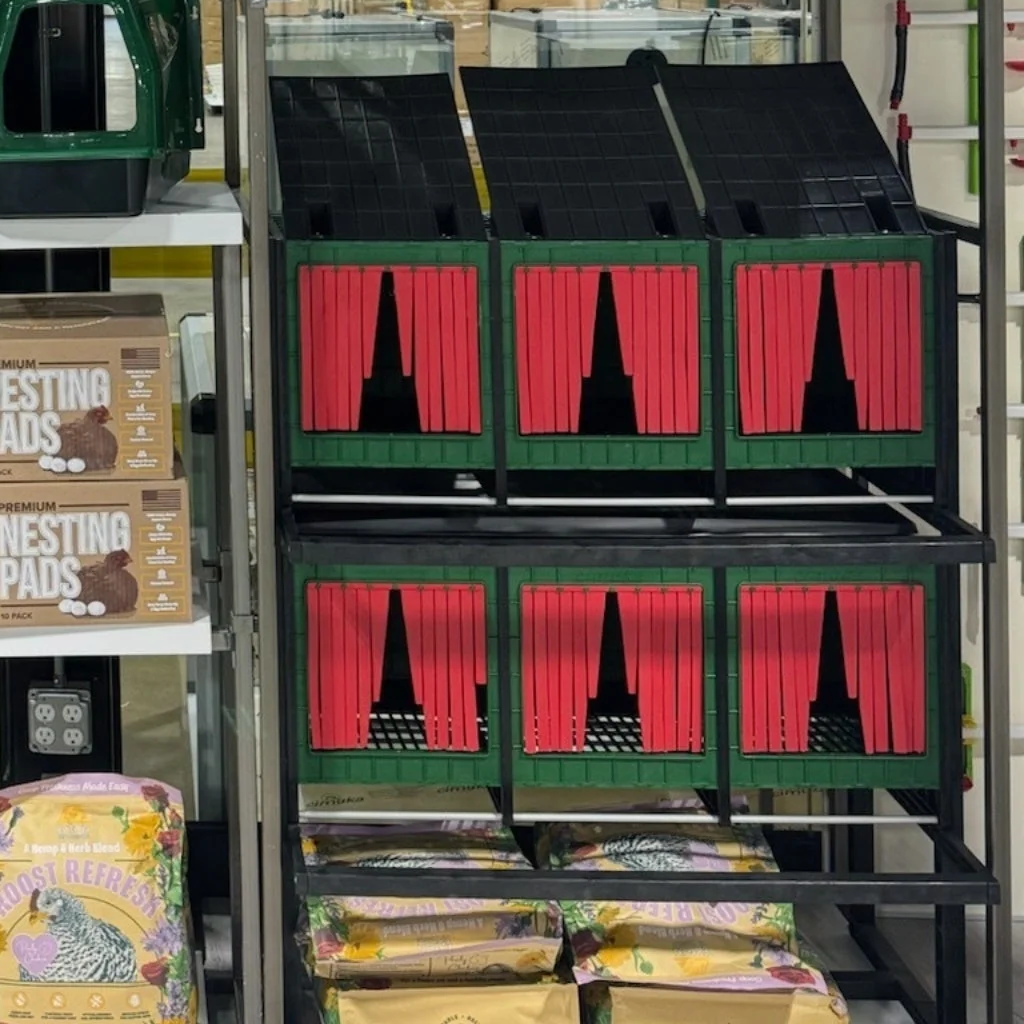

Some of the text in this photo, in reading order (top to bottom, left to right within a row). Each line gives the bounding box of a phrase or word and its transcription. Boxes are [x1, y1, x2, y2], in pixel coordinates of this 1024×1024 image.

[11, 612, 32, 620] PACK
[92, 842, 120, 853] Blend
[64, 858, 162, 918] REFRESH
